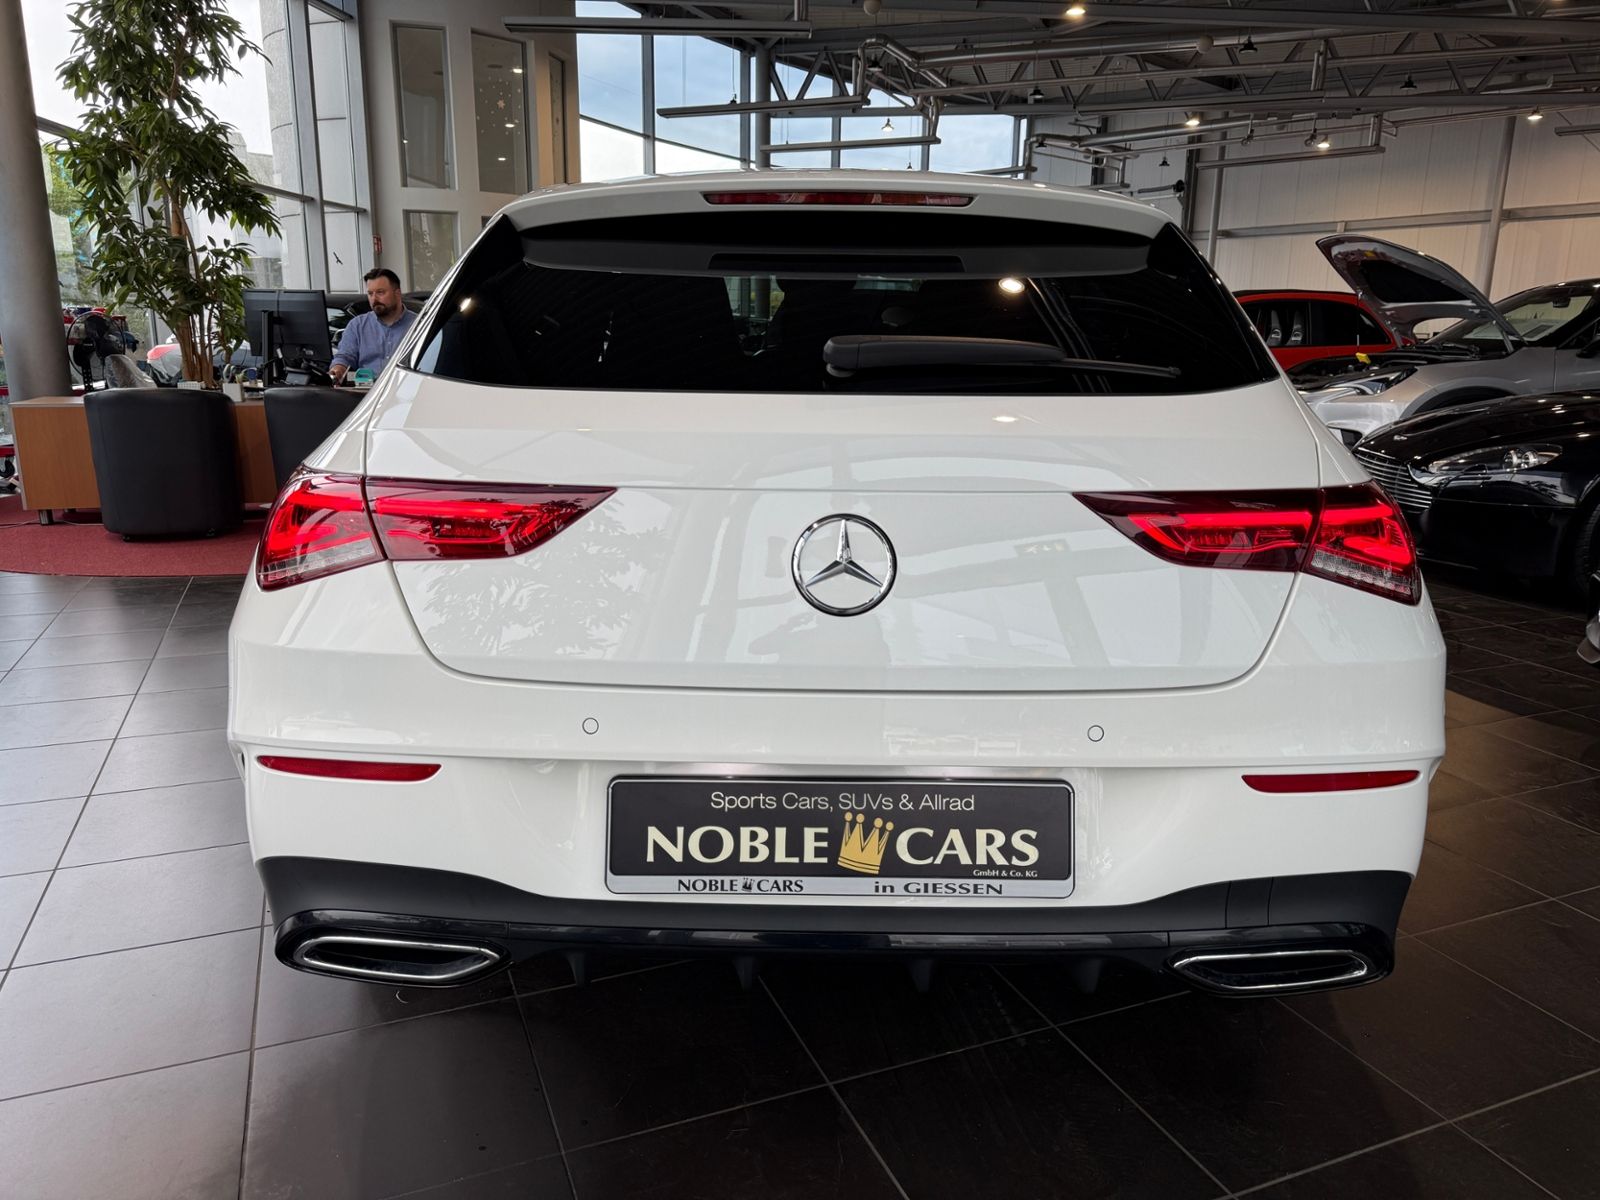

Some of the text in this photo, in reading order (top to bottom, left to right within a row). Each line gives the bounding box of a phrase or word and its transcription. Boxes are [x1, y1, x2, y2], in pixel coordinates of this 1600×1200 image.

[711, 792, 975, 812] Sports Cars, SUVs & Allrad
[646, 825, 1038, 866] NOBLE CARS
[678, 879, 1003, 895] NOBLE CARS in GIESSEN
